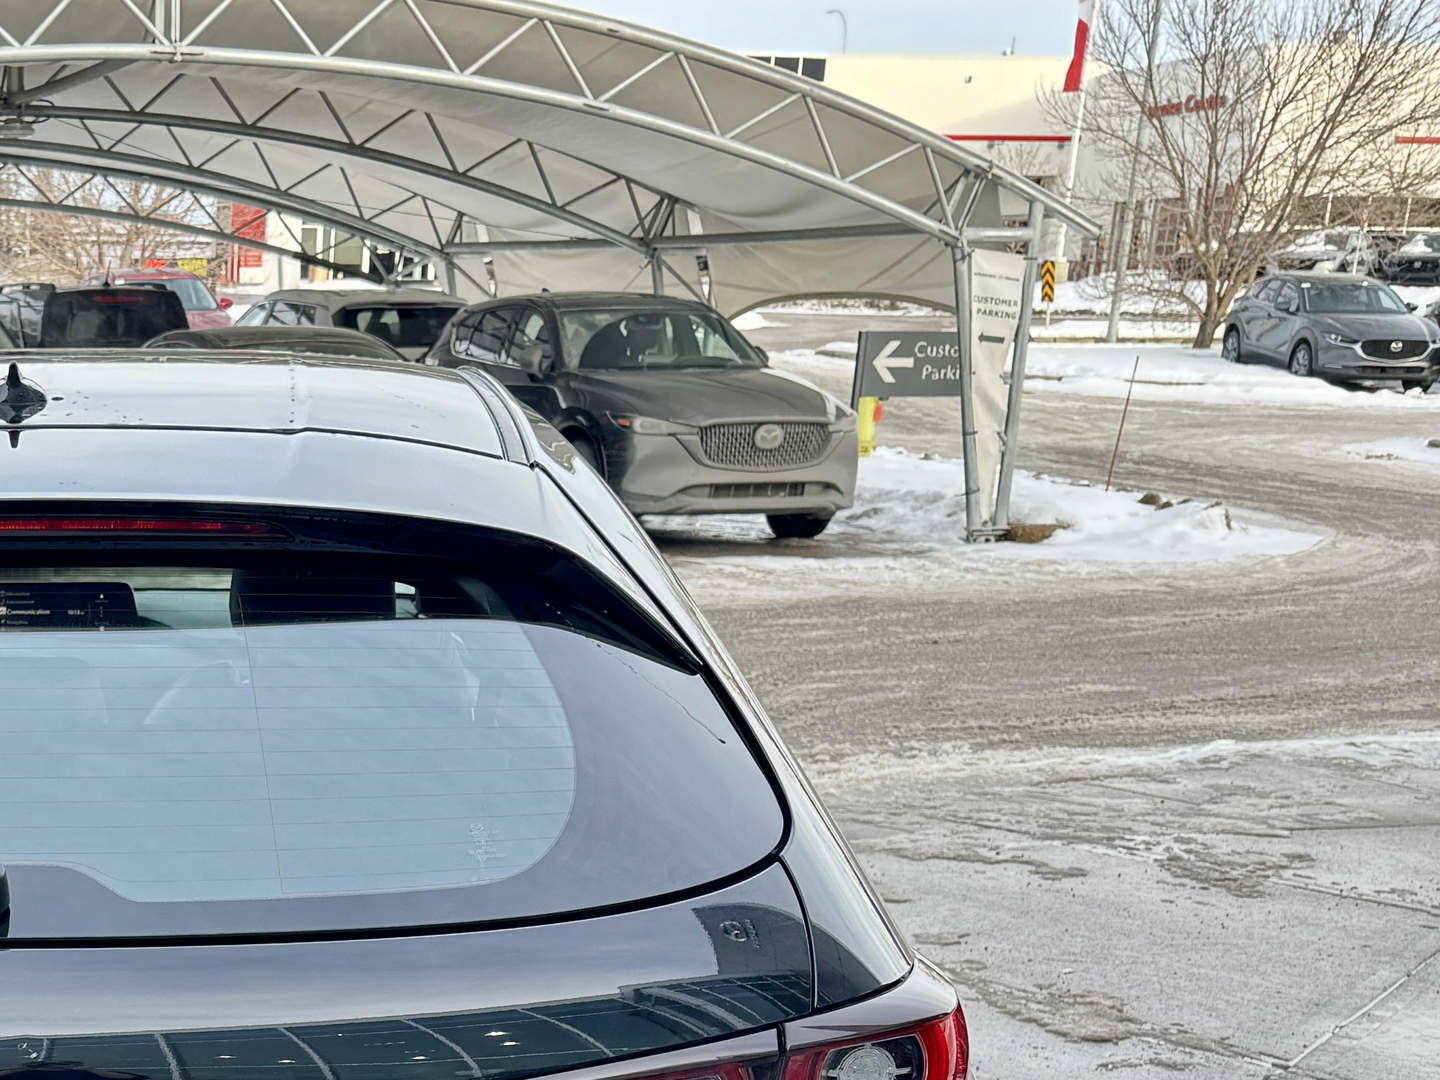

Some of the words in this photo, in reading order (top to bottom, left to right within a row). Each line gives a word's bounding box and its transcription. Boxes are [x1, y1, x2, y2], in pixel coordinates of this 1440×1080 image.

[973, 295, 1019, 307] CUSTOMER
[976, 308, 1017, 320] PARKING
[914, 341, 960, 358] Custo
[921, 364, 961, 380] Parki
